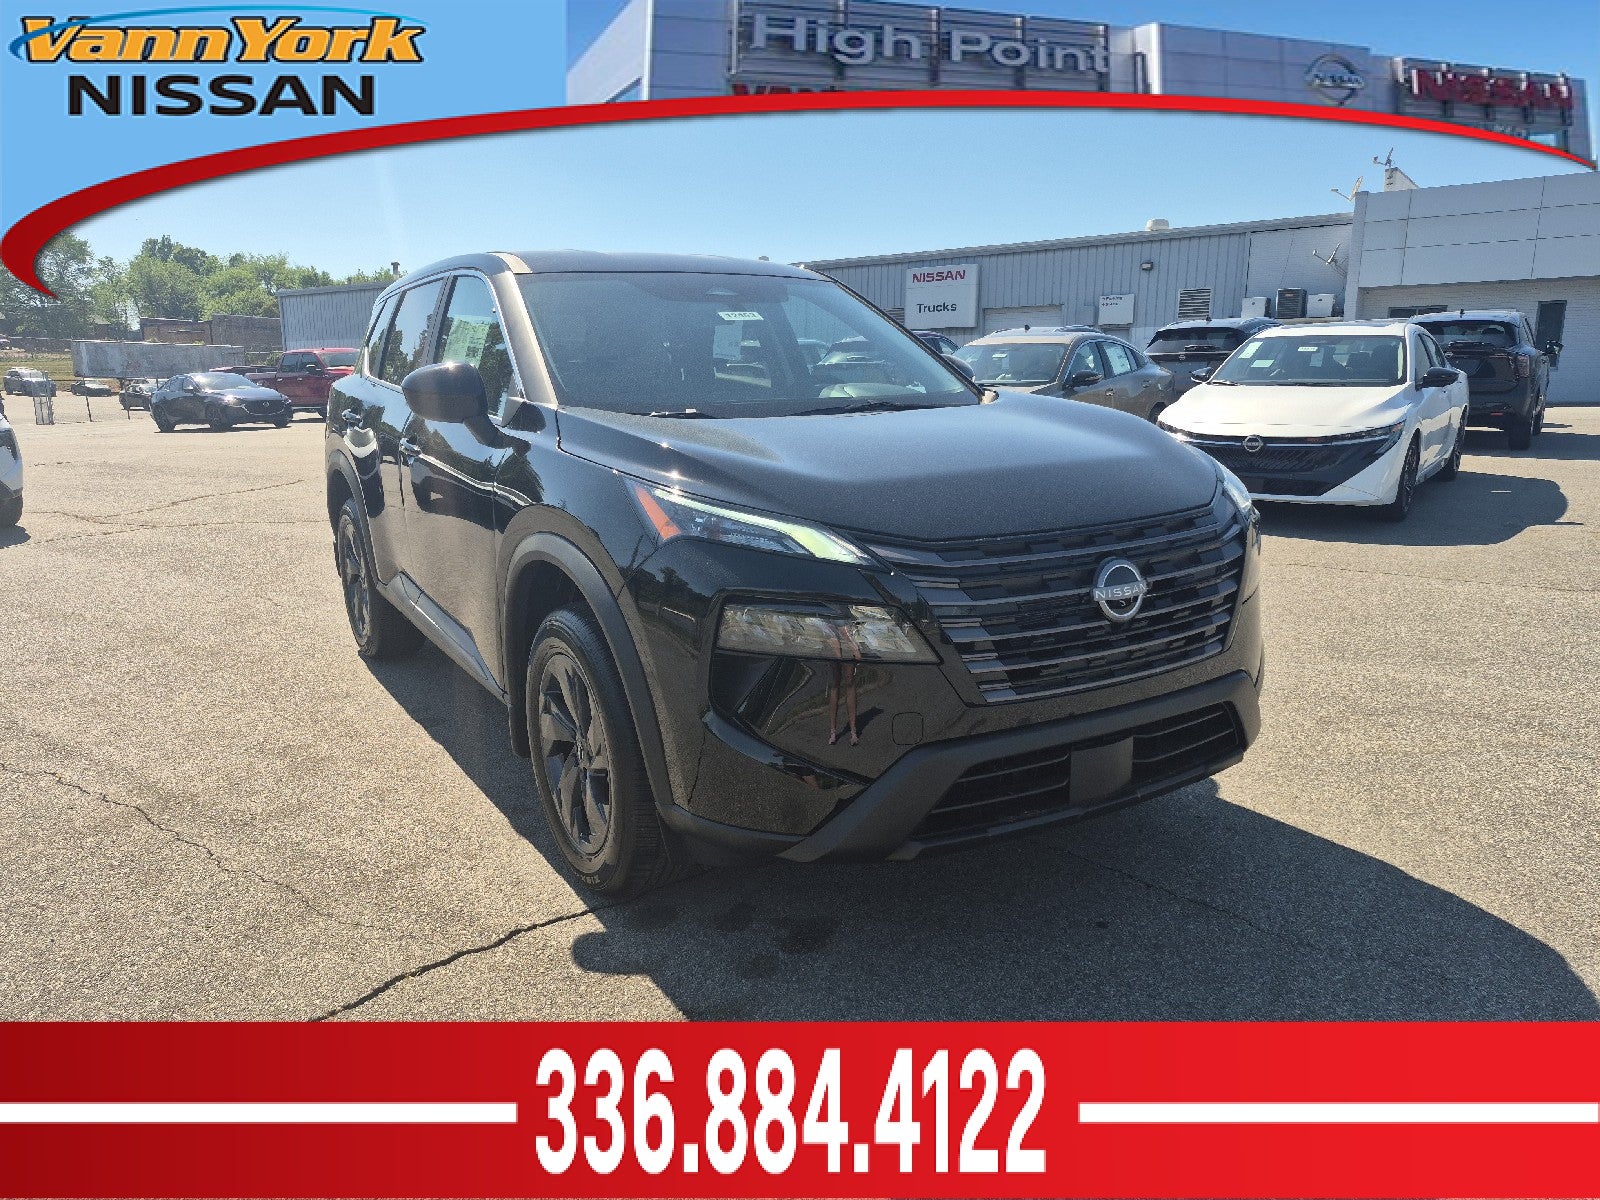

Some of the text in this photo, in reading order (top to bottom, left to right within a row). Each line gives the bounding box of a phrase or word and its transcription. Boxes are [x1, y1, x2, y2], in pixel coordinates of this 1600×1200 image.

[912, 269, 966, 284] NISSAN
[916, 301, 957, 314] Trucks
[1095, 583, 1146, 599] NISSAN
